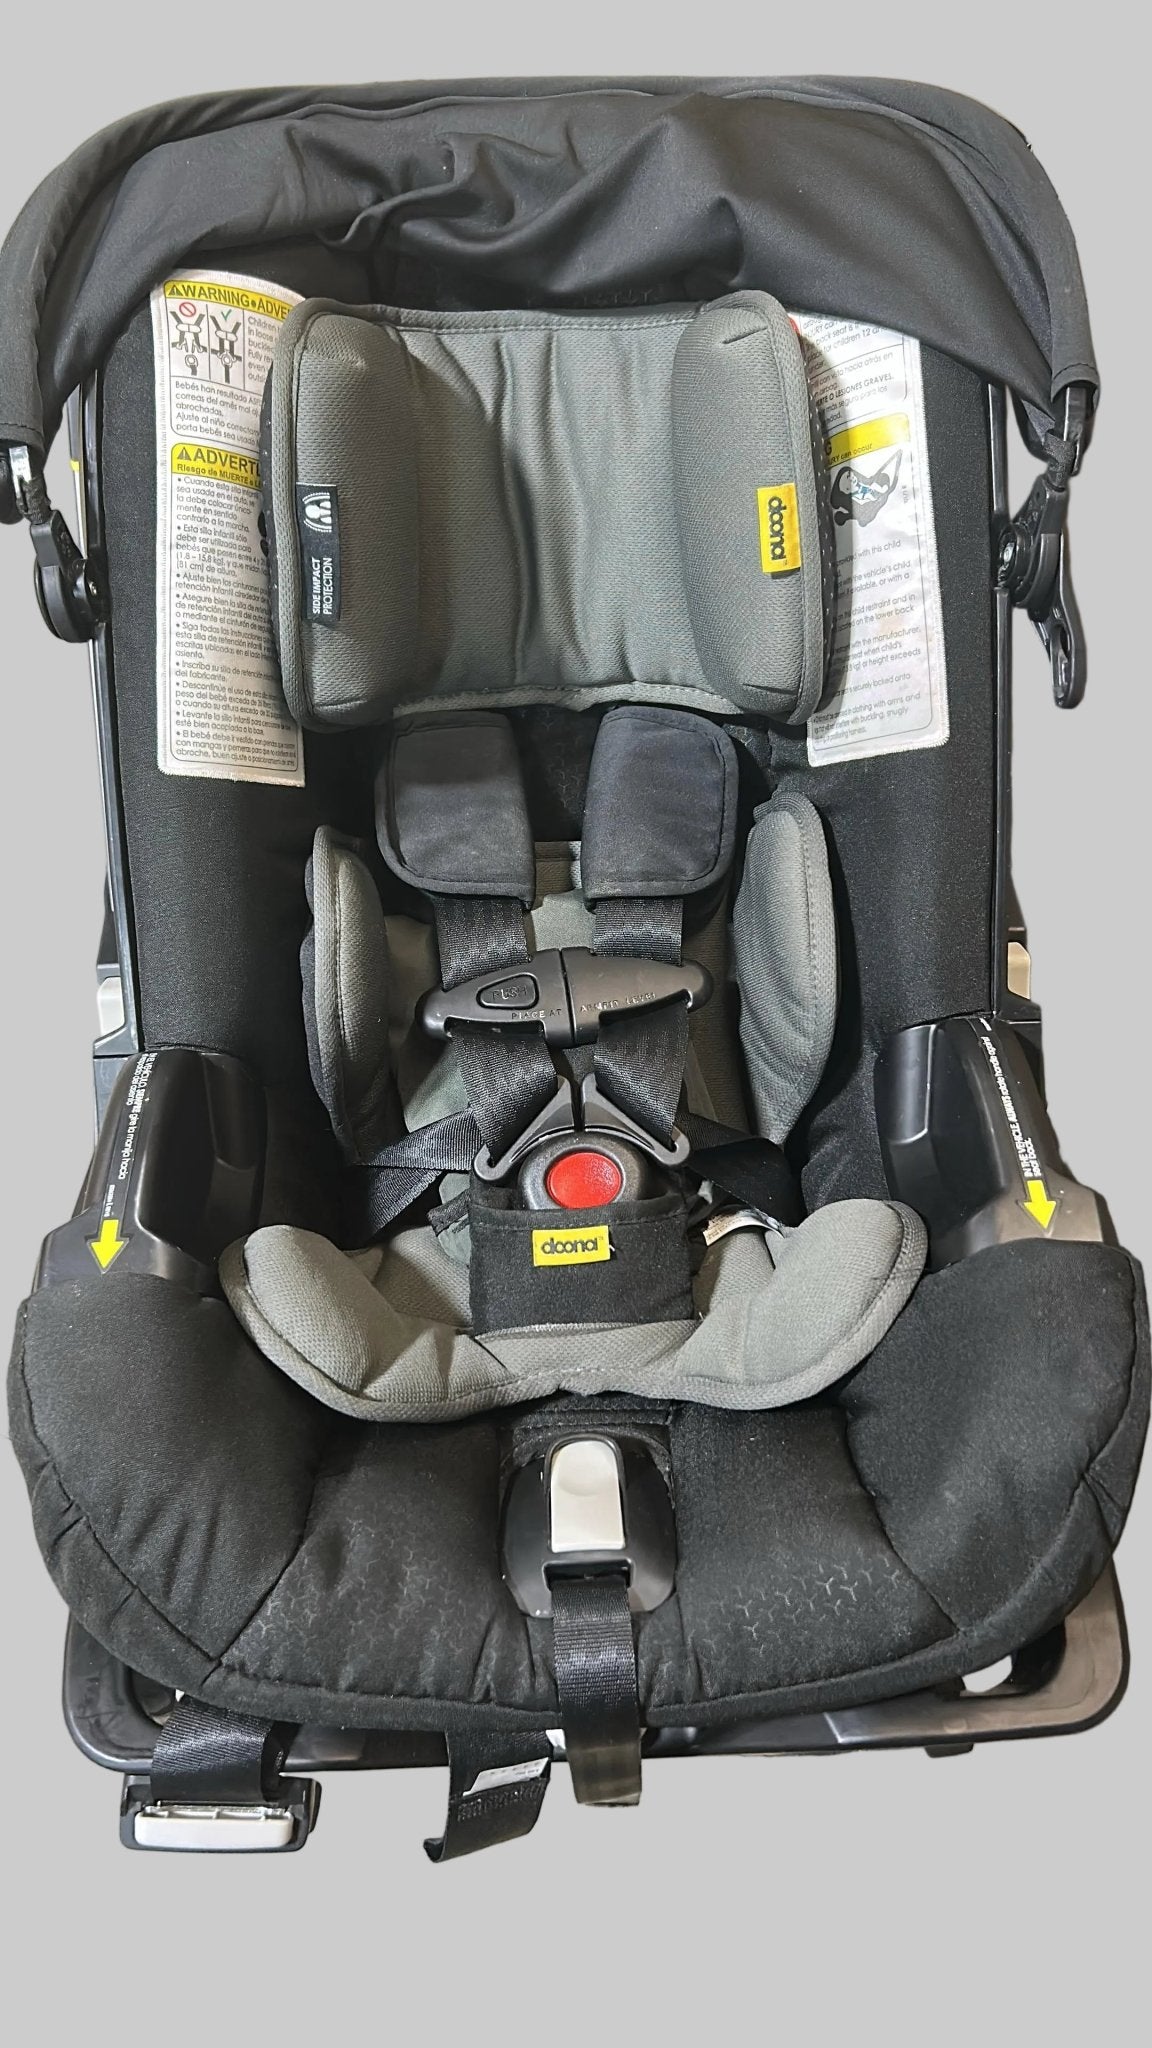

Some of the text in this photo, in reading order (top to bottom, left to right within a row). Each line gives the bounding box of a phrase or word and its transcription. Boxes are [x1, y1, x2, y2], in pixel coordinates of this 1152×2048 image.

[182, 285, 250, 307] WARNING
[248, 316, 276, 331] Children
[175, 380, 199, 392] Bebés
[201, 383, 216, 394] han
[216, 388, 248, 403] resultado
[175, 392, 205, 403] correas
[206, 395, 218, 406] del
[176, 412, 199, 423] Ajuste
[176, 422, 198, 433] porta
[199, 424, 222, 437] bebés
[183, 476, 214, 487] Cuando
[219, 469, 249, 484] MUERTE
[176, 485, 226, 500] sea usada en
[176, 493, 234, 510] la debe colocar
[176, 503, 238, 520] mente en sentido
[176, 513, 210, 524] contrario
[183, 523, 199, 533] Esta
[199, 526, 213, 535] silla
[768, 496, 787, 560] doona
[176, 533, 197, 542] debe
[198, 537, 210, 545] ser
[176, 542, 200, 550] bebés
[201, 545, 216, 555] que
[883, 541, 902, 550] child
[205, 564, 216, 573] de
[863, 560, 910, 576] vehicle's child
[182, 572, 204, 581] Ajuste
[206, 574, 222, 583] bien
[175, 580, 211, 591] retención
[311, 556, 321, 614] SIDE IMPACT
[322, 557, 333, 615] PROTECTION
[182, 592, 229, 606] Asegure bien
[865, 599, 890, 610] restraint
[891, 595, 906, 604] and
[187, 604, 222, 614] retención
[875, 610, 894, 620] lower
[894, 604, 914, 614] back
[182, 612, 218, 623] mediante
[182, 622, 220, 632] Siga todas
[175, 640, 204, 648] escritas
[868, 648, 922, 665] height exceeds
[182, 661, 211, 669] Inscriba
[872, 673, 910, 686] locked onto
[195, 690, 208, 698] del
[208, 692, 228, 700] bebé
[905, 693, 922, 702] and
[182, 700, 213, 708] cuando
[182, 710, 213, 718] Levante
[175, 718, 192, 726] esté
[190, 730, 211, 738] bebé
[192, 741, 222, 750] mangas
[212, 750, 230, 758] buen
[492, 985, 528, 1001] PUSH
[511, 1010, 546, 1020] PLACE
[549, 1008, 563, 1017] AT
[541, 1237, 599, 1255] doona
